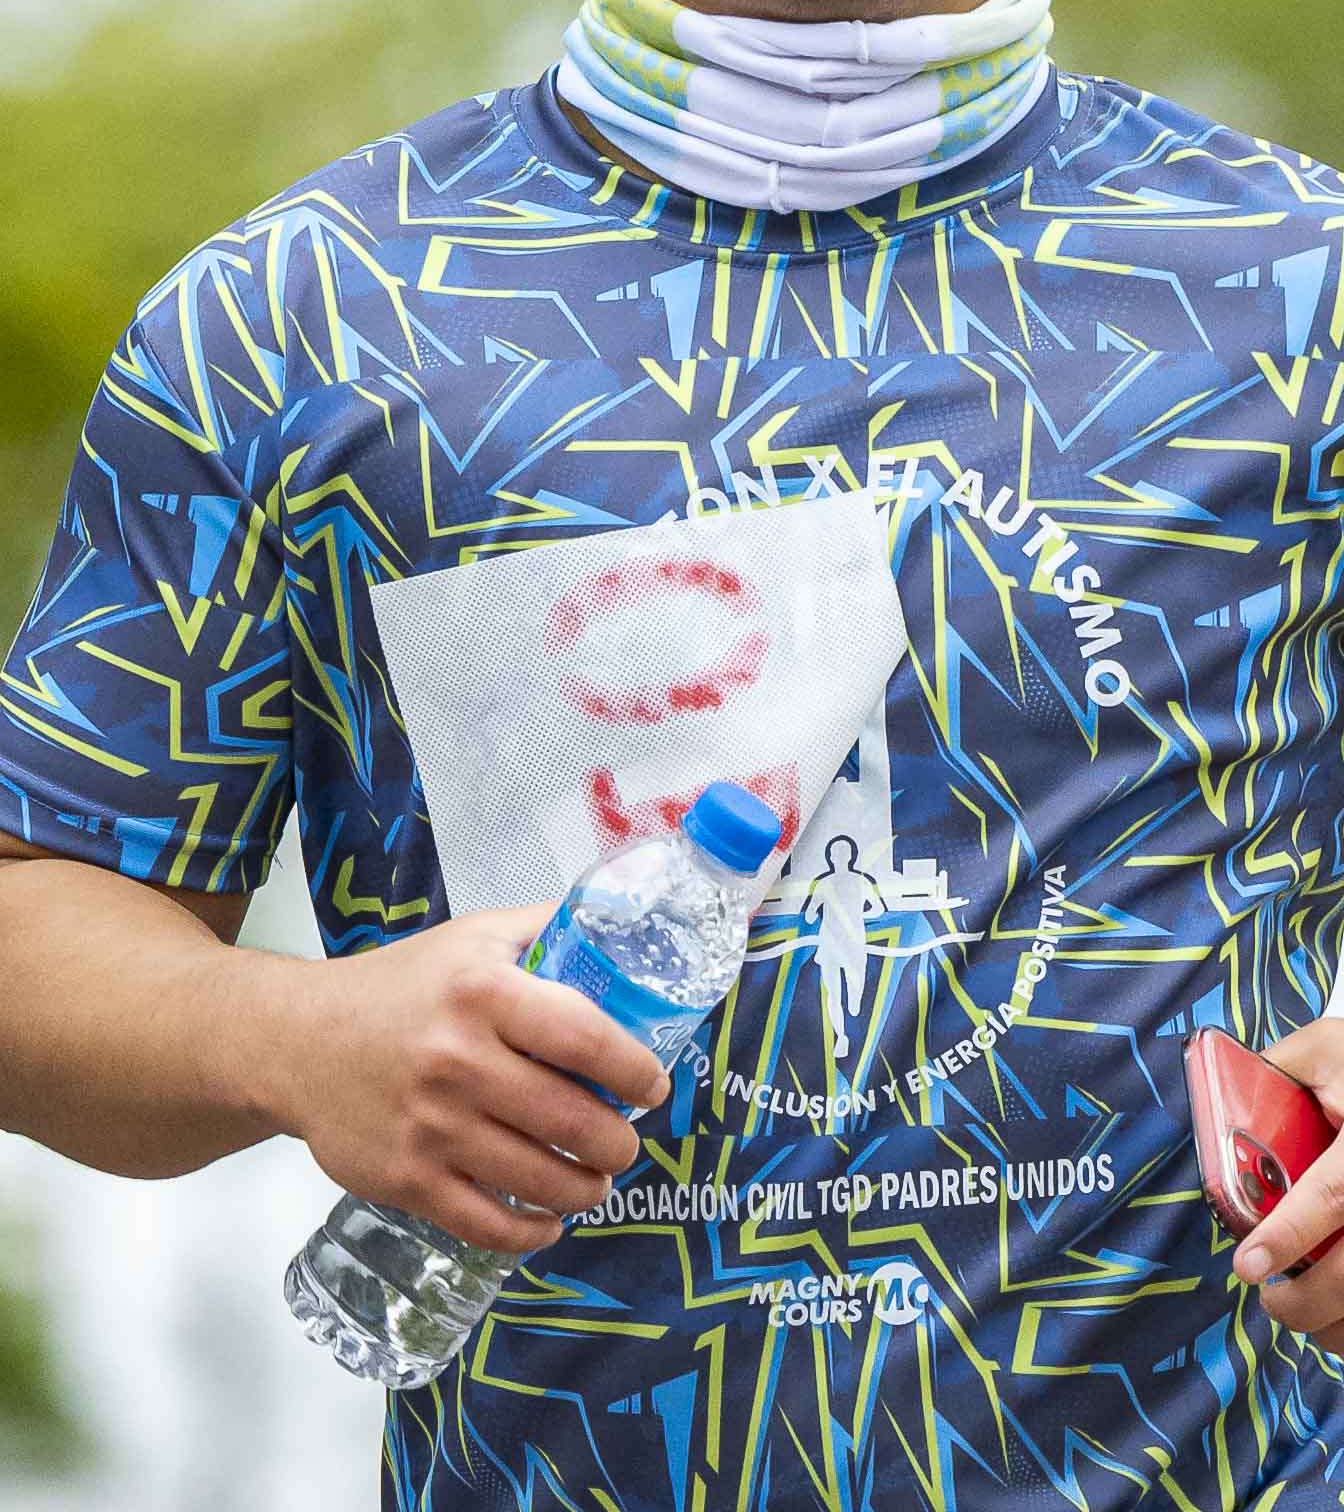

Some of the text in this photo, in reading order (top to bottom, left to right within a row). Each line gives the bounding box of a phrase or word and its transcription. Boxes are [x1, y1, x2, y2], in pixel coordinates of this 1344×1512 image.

[802, 454, 855, 499] X
[867, 454, 923, 498] EL
[940, 467, 1131, 708] AUTISMO
[683, 1041, 712, 1088] TO,
[720, 1070, 877, 1120] INCLUSIÓN
[880, 1078, 898, 1103] Y
[1013, 864, 1067, 1001] POSITIVA
[746, 1181, 813, 1221] CIVIL
[817, 1174, 873, 1216] TGD
[881, 1165, 998, 1211] PADRES
[1006, 1153, 1116, 1201] UNIDOS
[748, 1273, 864, 1305] MAGNY
[768, 1298, 863, 1328] COURS
